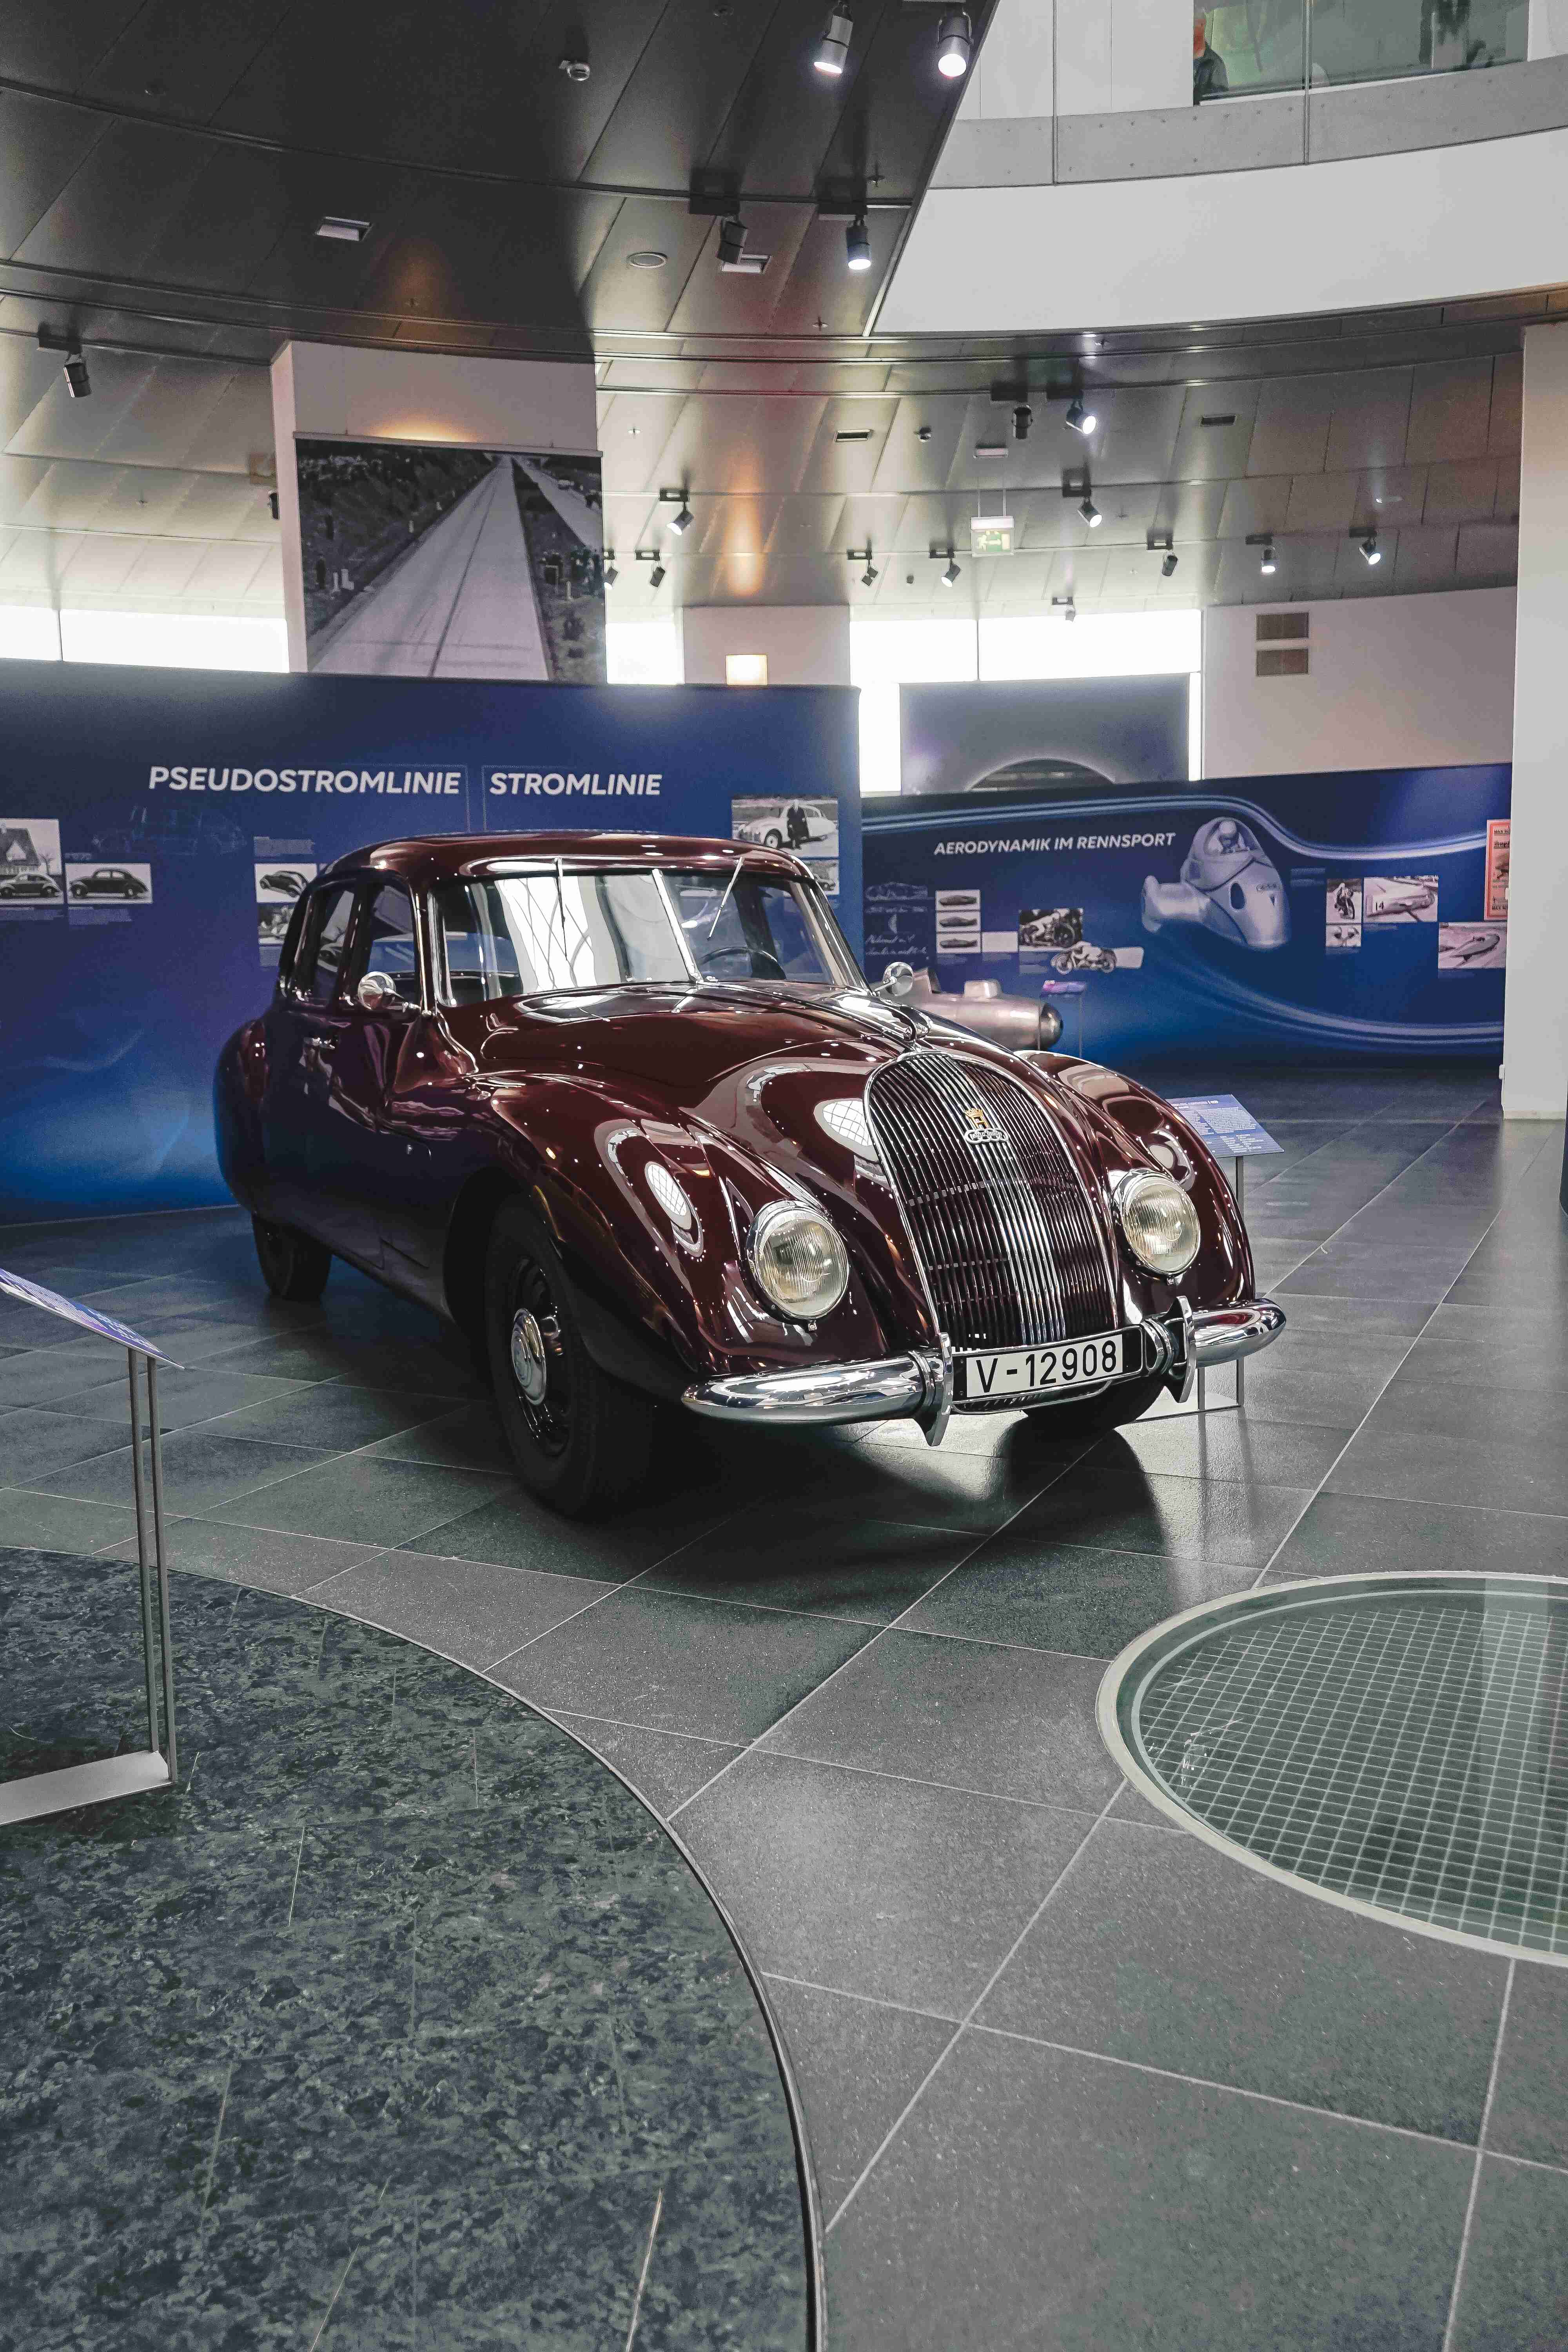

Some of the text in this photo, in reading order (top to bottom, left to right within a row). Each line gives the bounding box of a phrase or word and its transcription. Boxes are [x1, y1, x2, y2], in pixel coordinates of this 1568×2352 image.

[149, 766, 461, 795] PSEUDOSTROMLINIE
[489, 772, 662, 795] STROMLINIE
[933, 832, 1176, 855] AERODYNAMIK IM RENNSPORT
[976, 1340, 1116, 1393] V-12908
